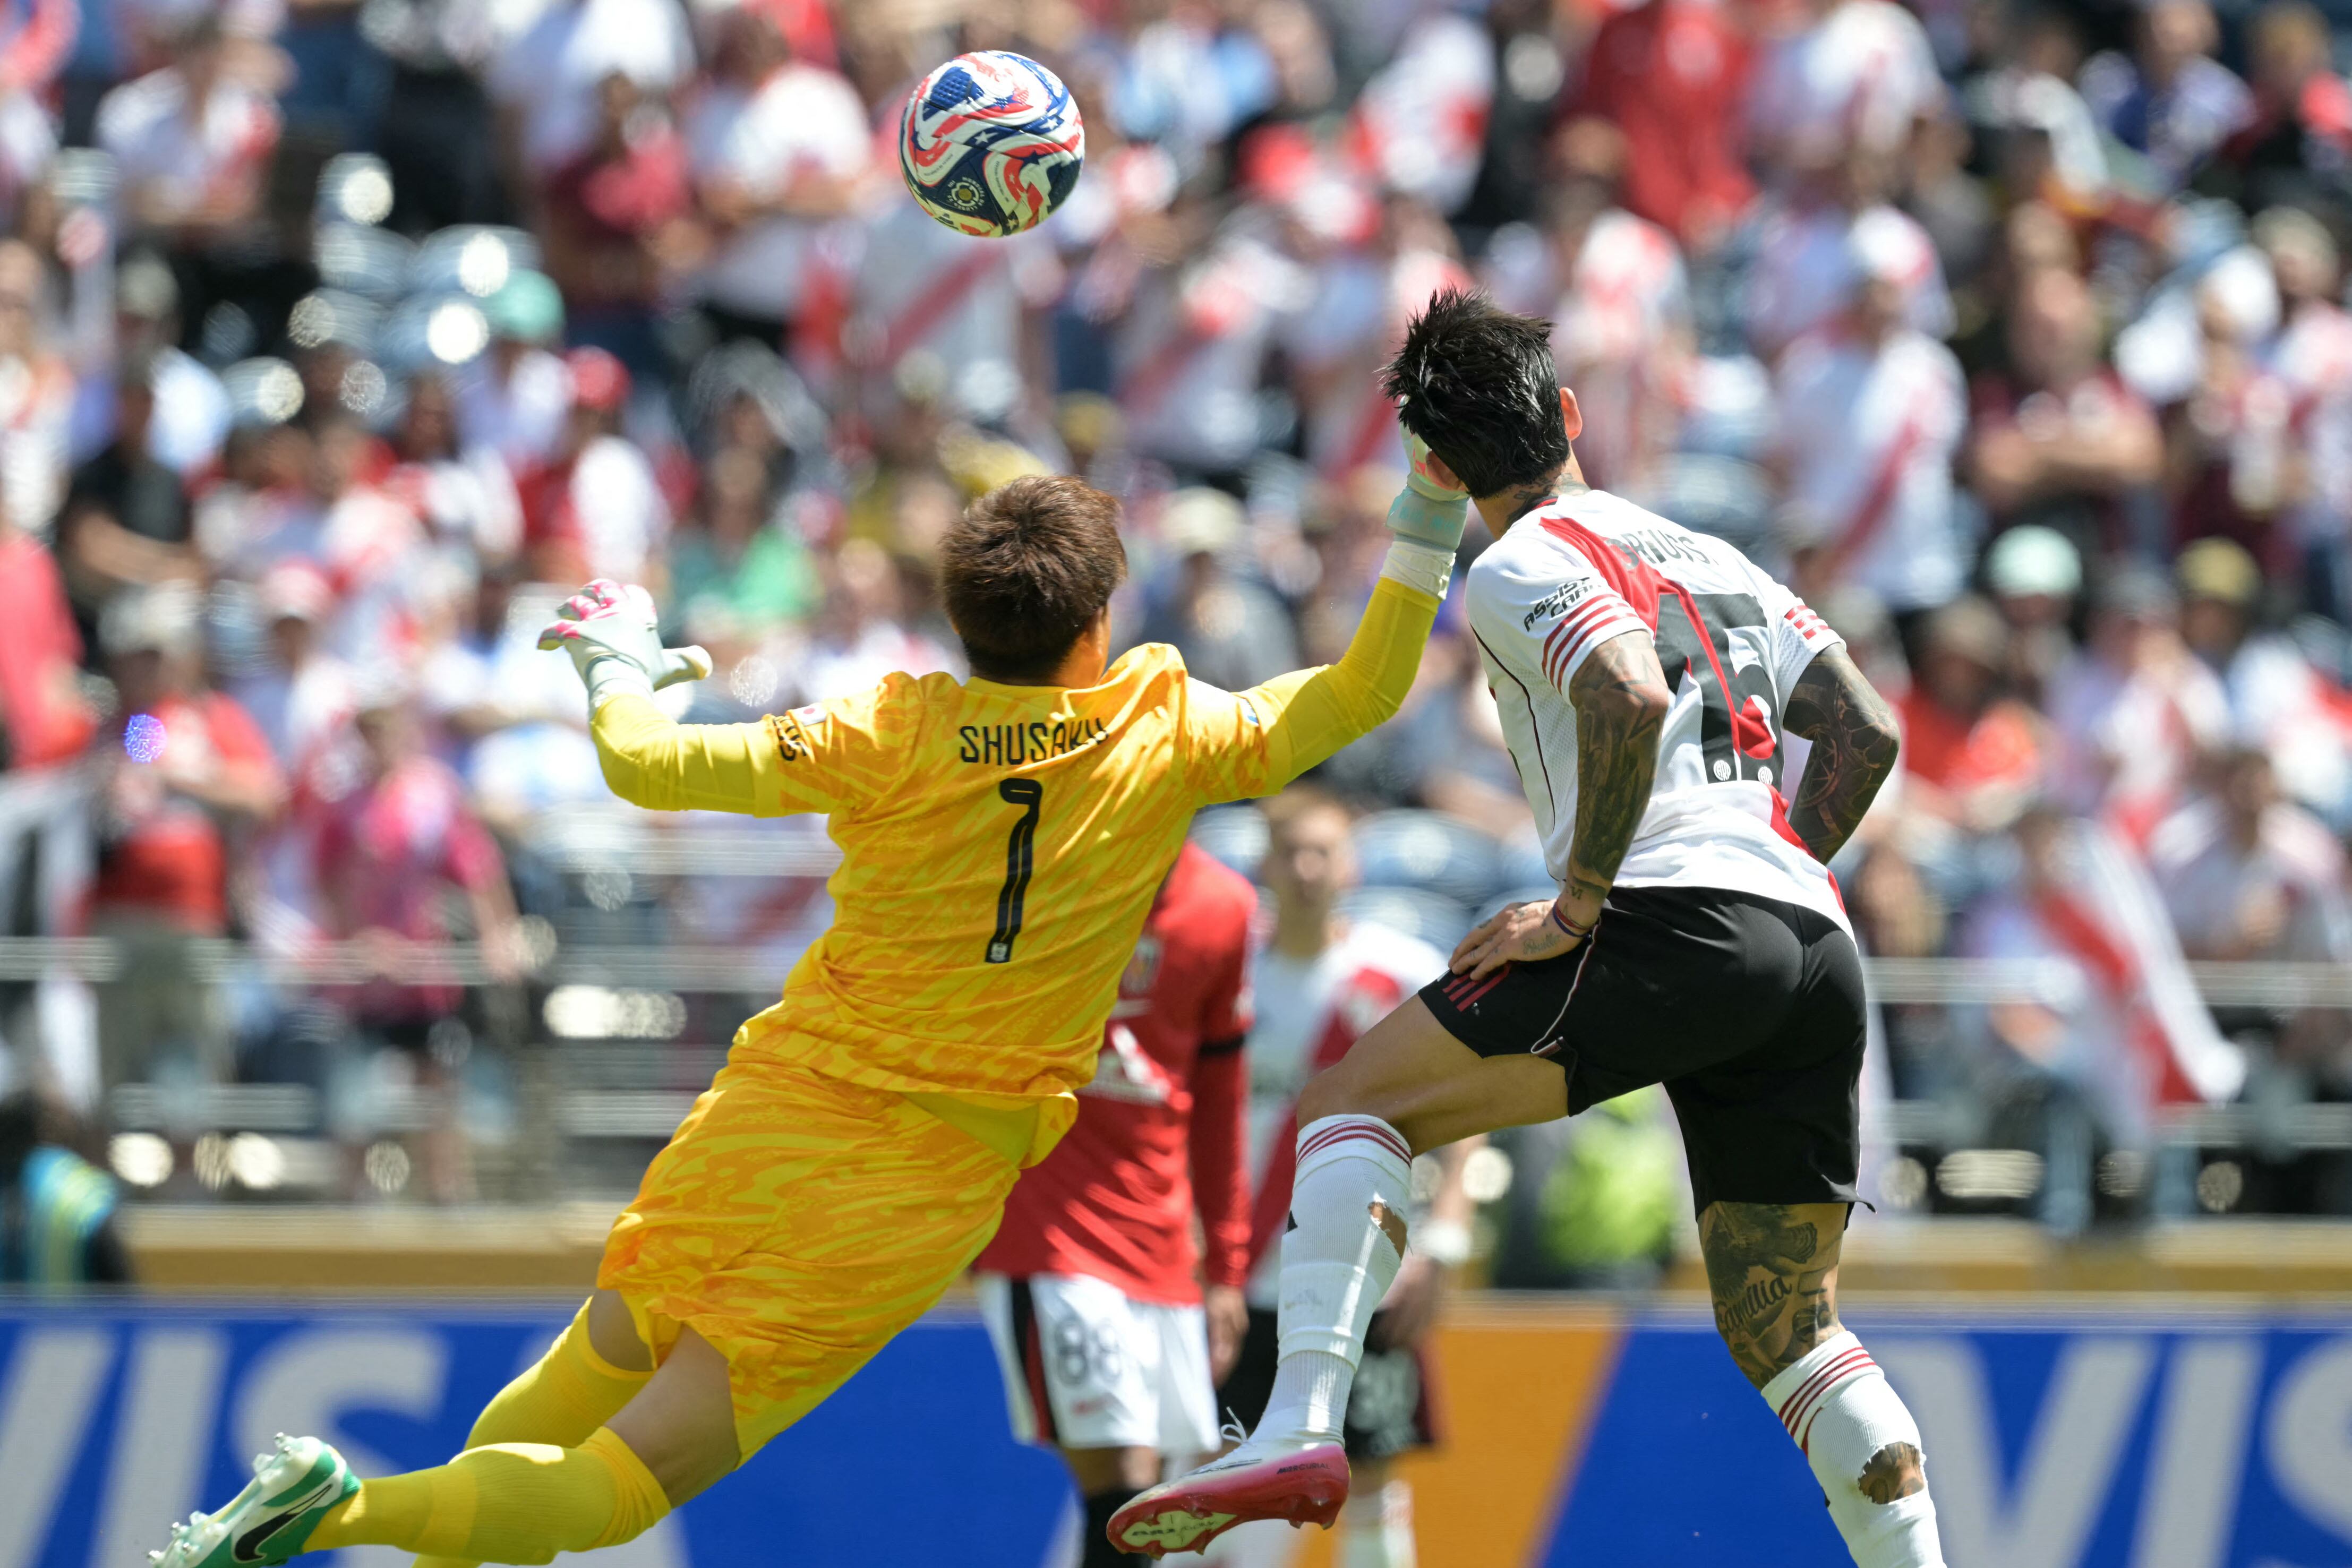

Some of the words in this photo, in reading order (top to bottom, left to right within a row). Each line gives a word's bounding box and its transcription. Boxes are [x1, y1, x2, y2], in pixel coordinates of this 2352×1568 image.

[1524, 577, 1590, 632] ASSIST
[1550, 585, 1602, 618] CAR
[960, 717, 1109, 766] SHUSAKU
